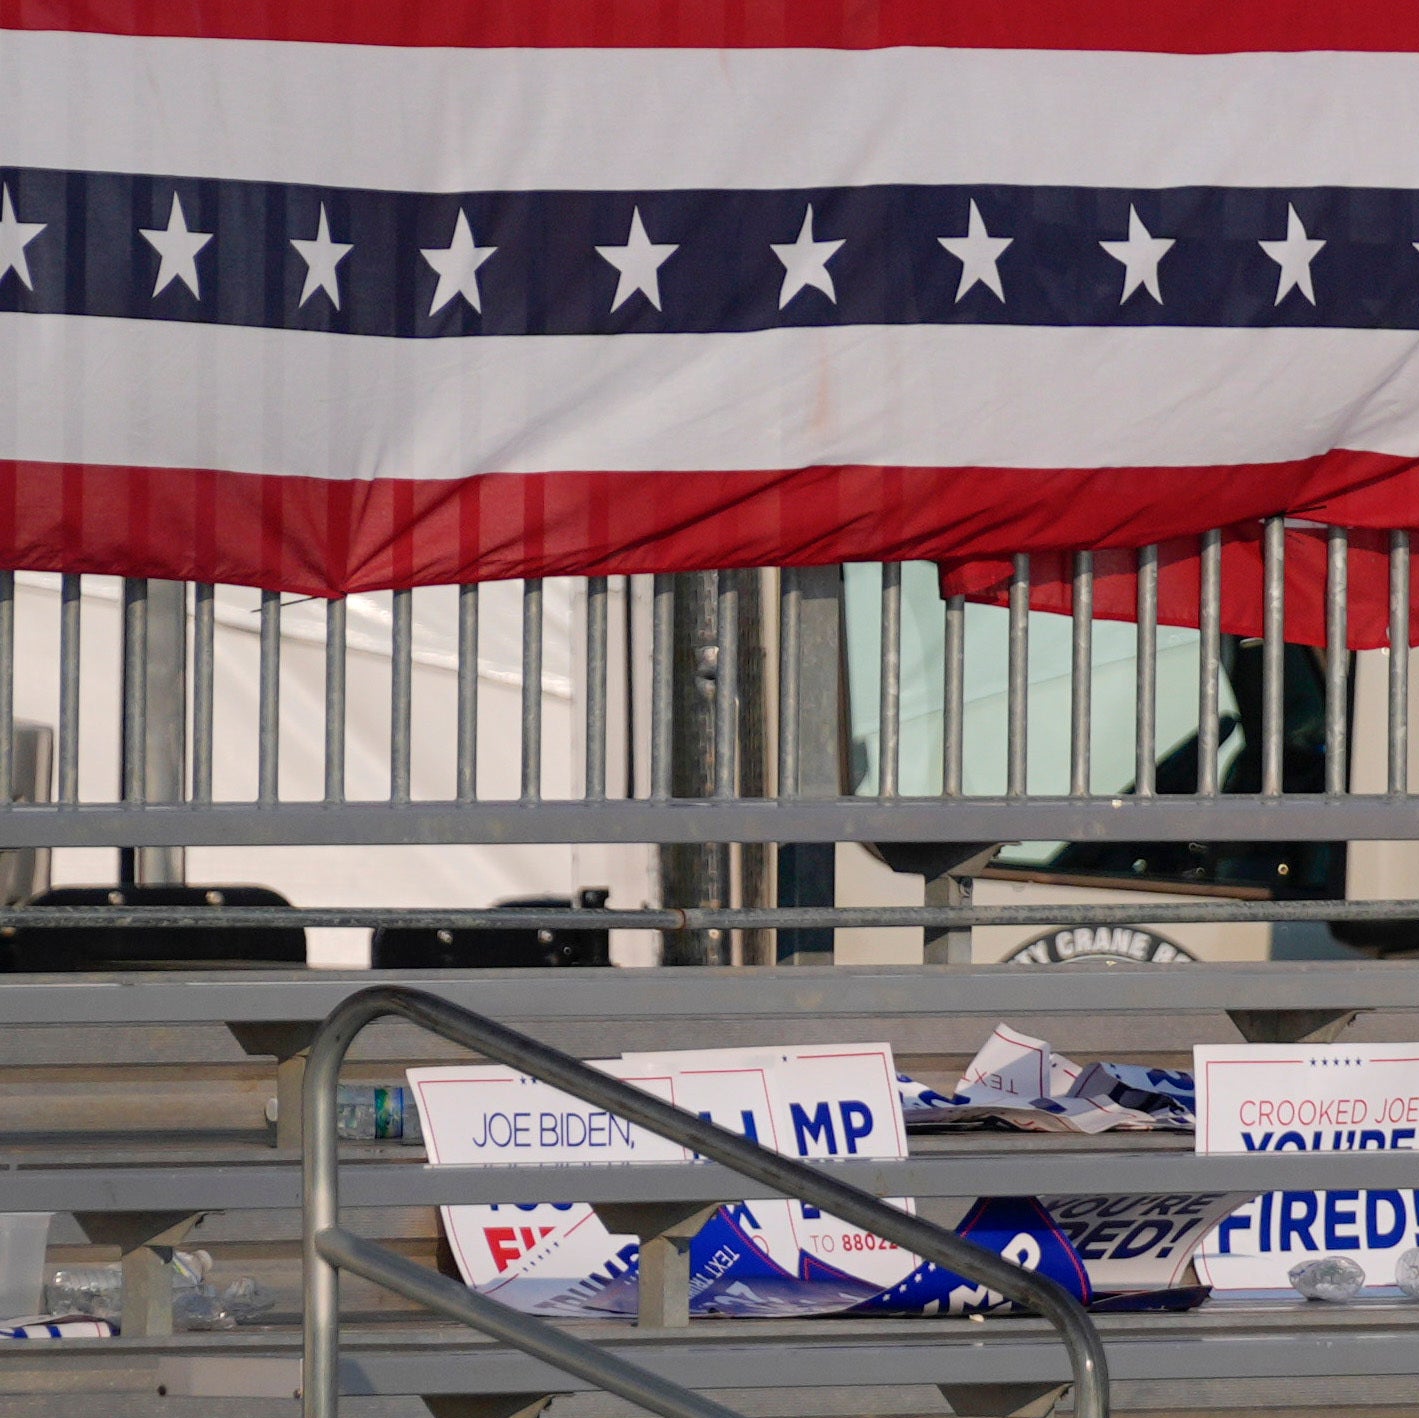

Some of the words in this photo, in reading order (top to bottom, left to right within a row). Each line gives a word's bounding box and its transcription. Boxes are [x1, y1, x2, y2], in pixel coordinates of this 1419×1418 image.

[1055, 926, 1152, 961] CRANE
[1239, 1098, 1368, 1127] CROOKED
[472, 1112, 531, 1148] JOE
[539, 1112, 635, 1150] BIDEN,
[810, 1234, 836, 1253] TO
[1059, 1218, 1203, 1260] RED!
[703, 1245, 741, 1278] TEXT
